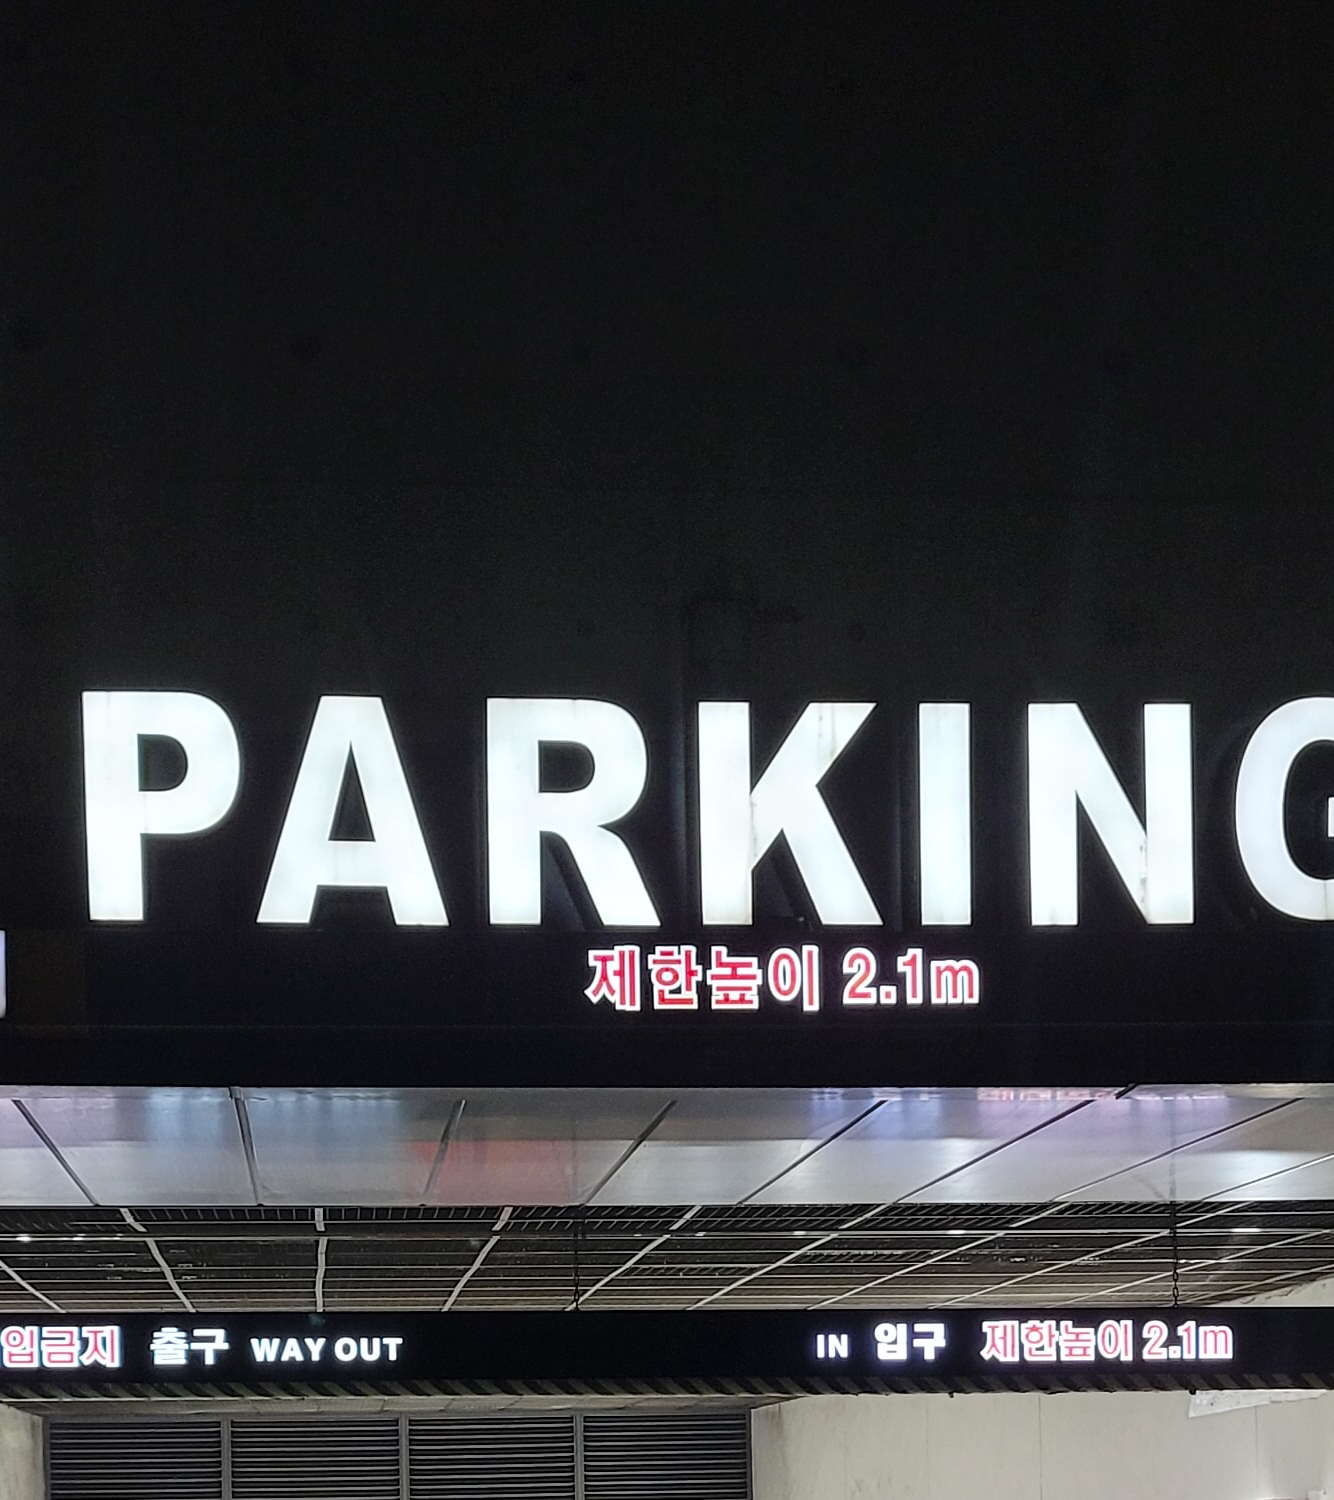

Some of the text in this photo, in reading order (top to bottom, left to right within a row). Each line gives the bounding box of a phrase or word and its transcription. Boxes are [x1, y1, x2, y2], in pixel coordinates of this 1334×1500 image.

[584, 944, 980, 1013] 제한높이 2.1m
[149, 1326, 230, 1366] 출구
[250, 1337, 326, 1363] WAY
[333, 1336, 404, 1362] OUT
[816, 1333, 849, 1359] IN
[873, 1322, 947, 1363] 입구
[979, 1319, 1234, 1363] 제한높이 2.1m
